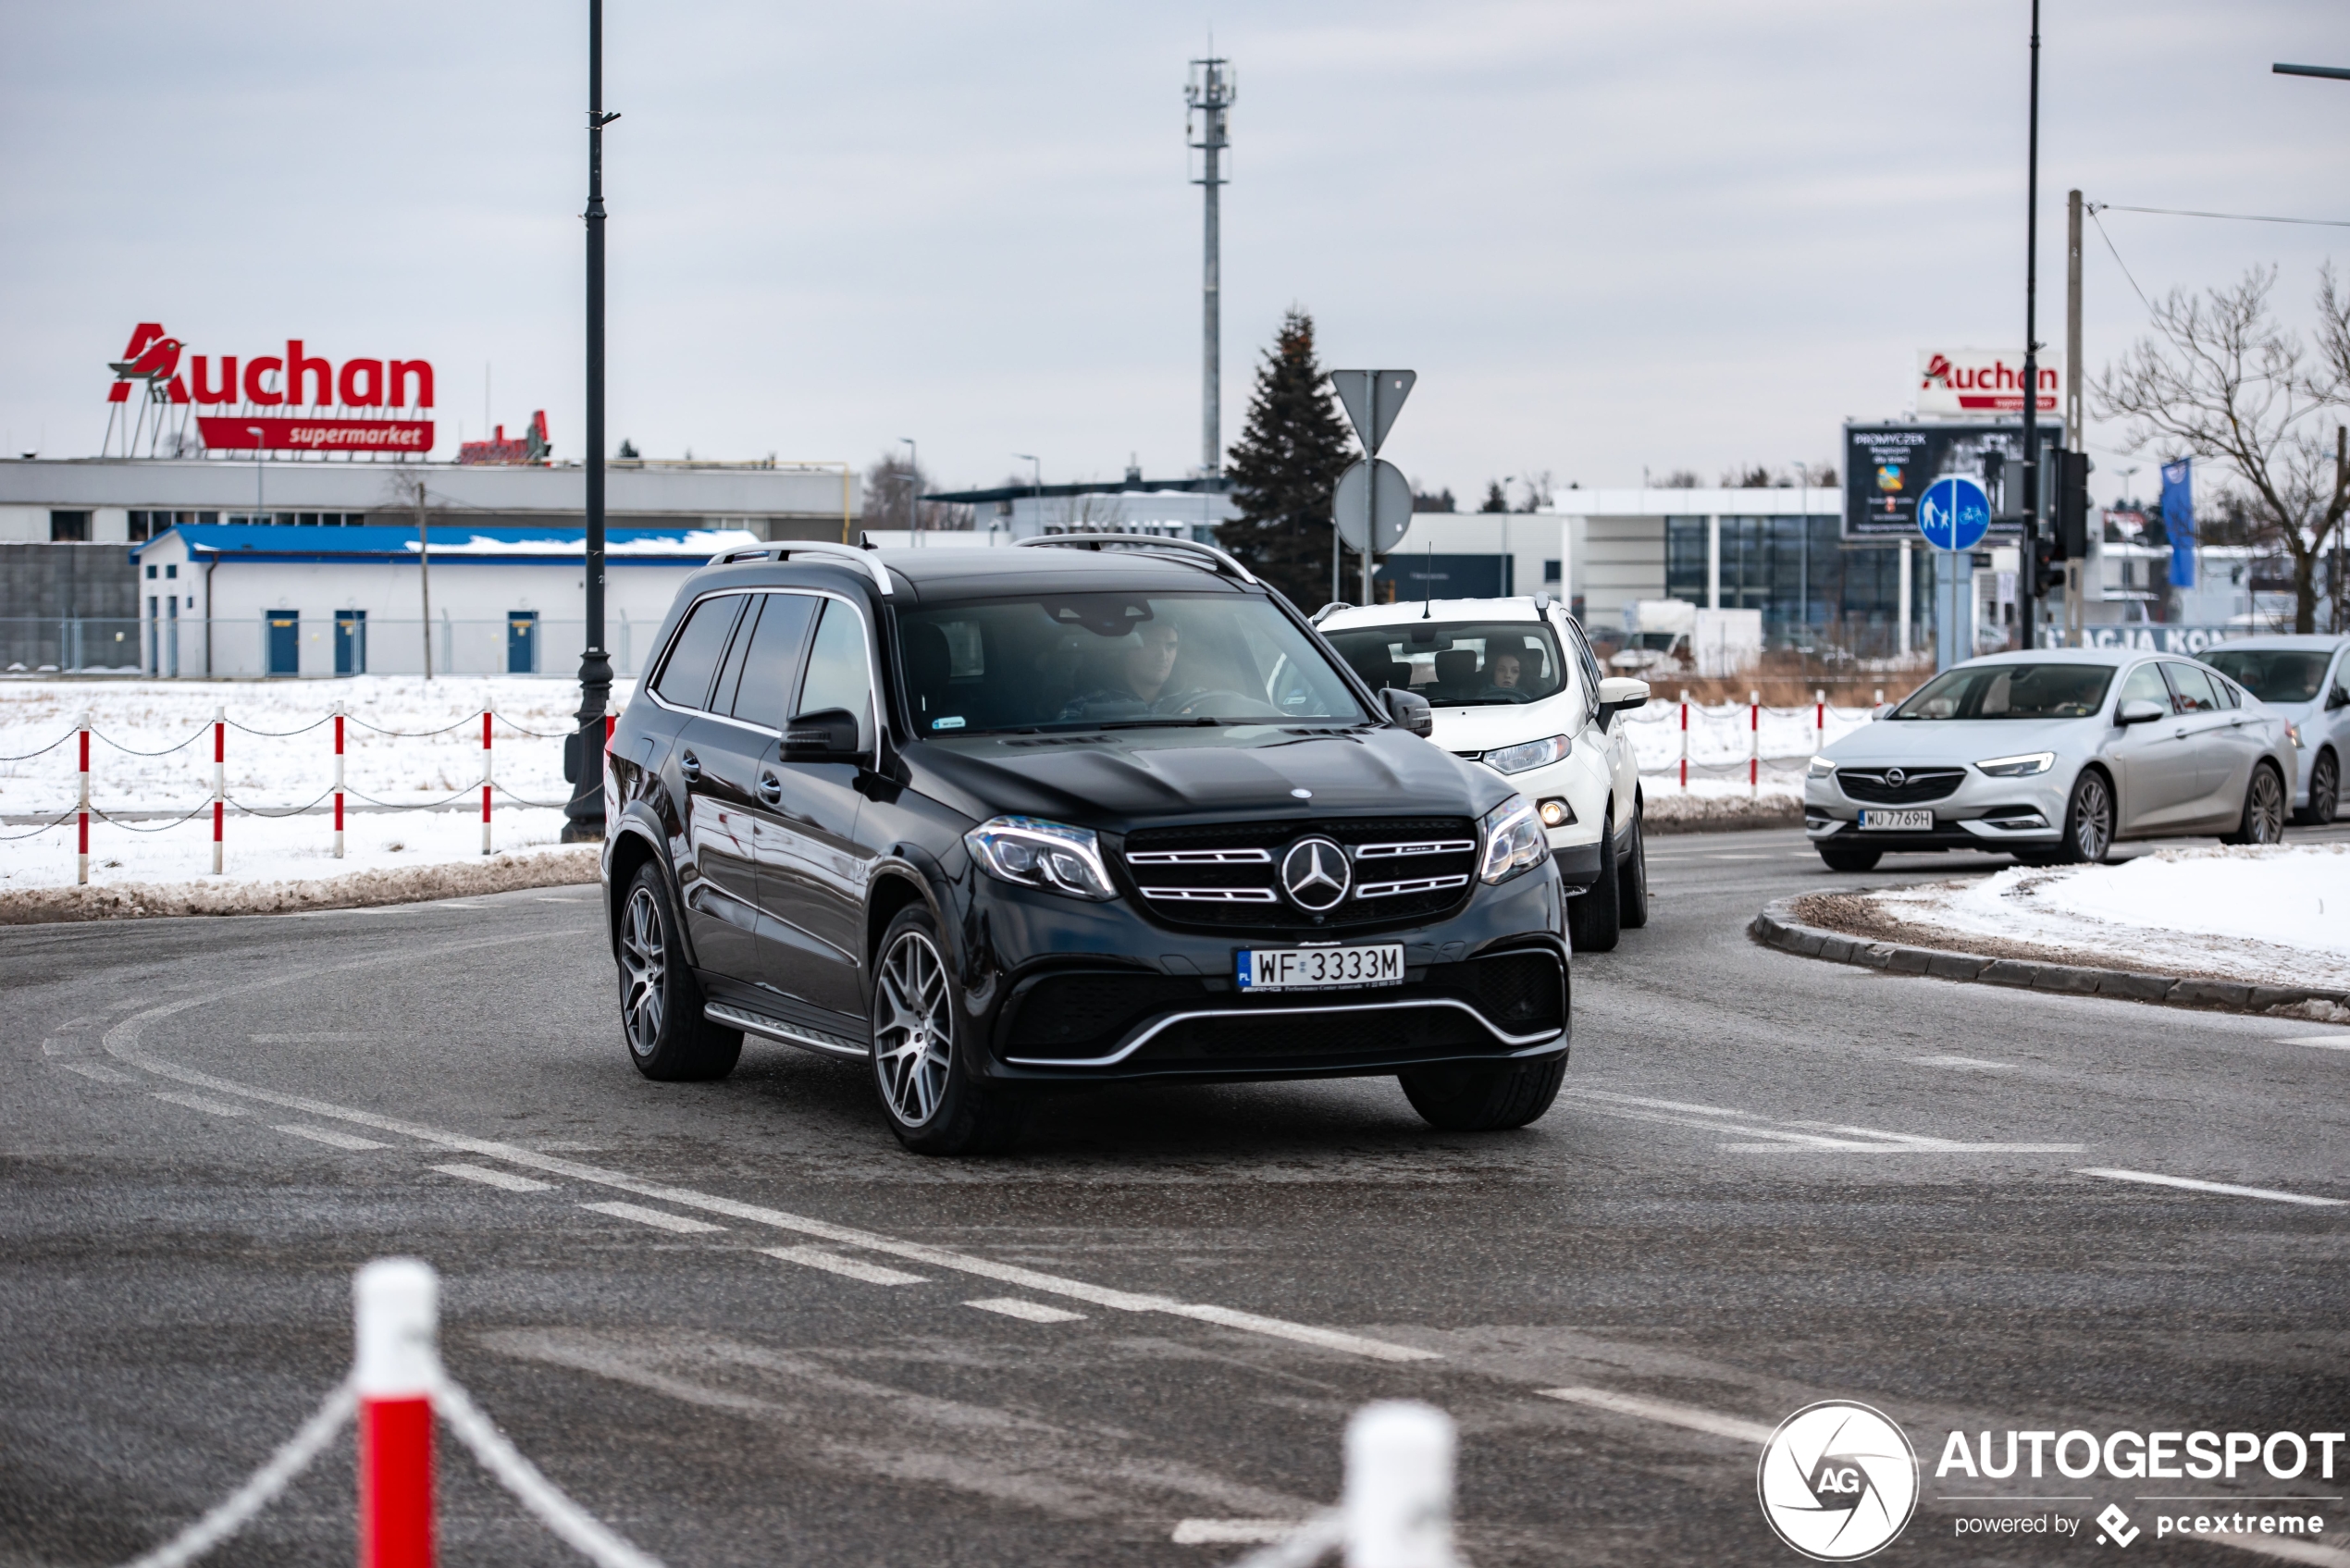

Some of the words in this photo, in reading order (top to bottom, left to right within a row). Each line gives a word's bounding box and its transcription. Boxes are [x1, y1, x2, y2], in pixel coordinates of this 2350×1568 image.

[106, 322, 434, 407] Auchan
[289, 425, 423, 449] supermarket
[1853, 432, 1926, 446] PROMYCZEK
[1867, 812, 1883, 826] WU
[1888, 812, 1929, 826] 7769H
[1259, 953, 1297, 982] WF
[1311, 948, 1397, 982] 3333M
[1239, 973, 1251, 982] PL
